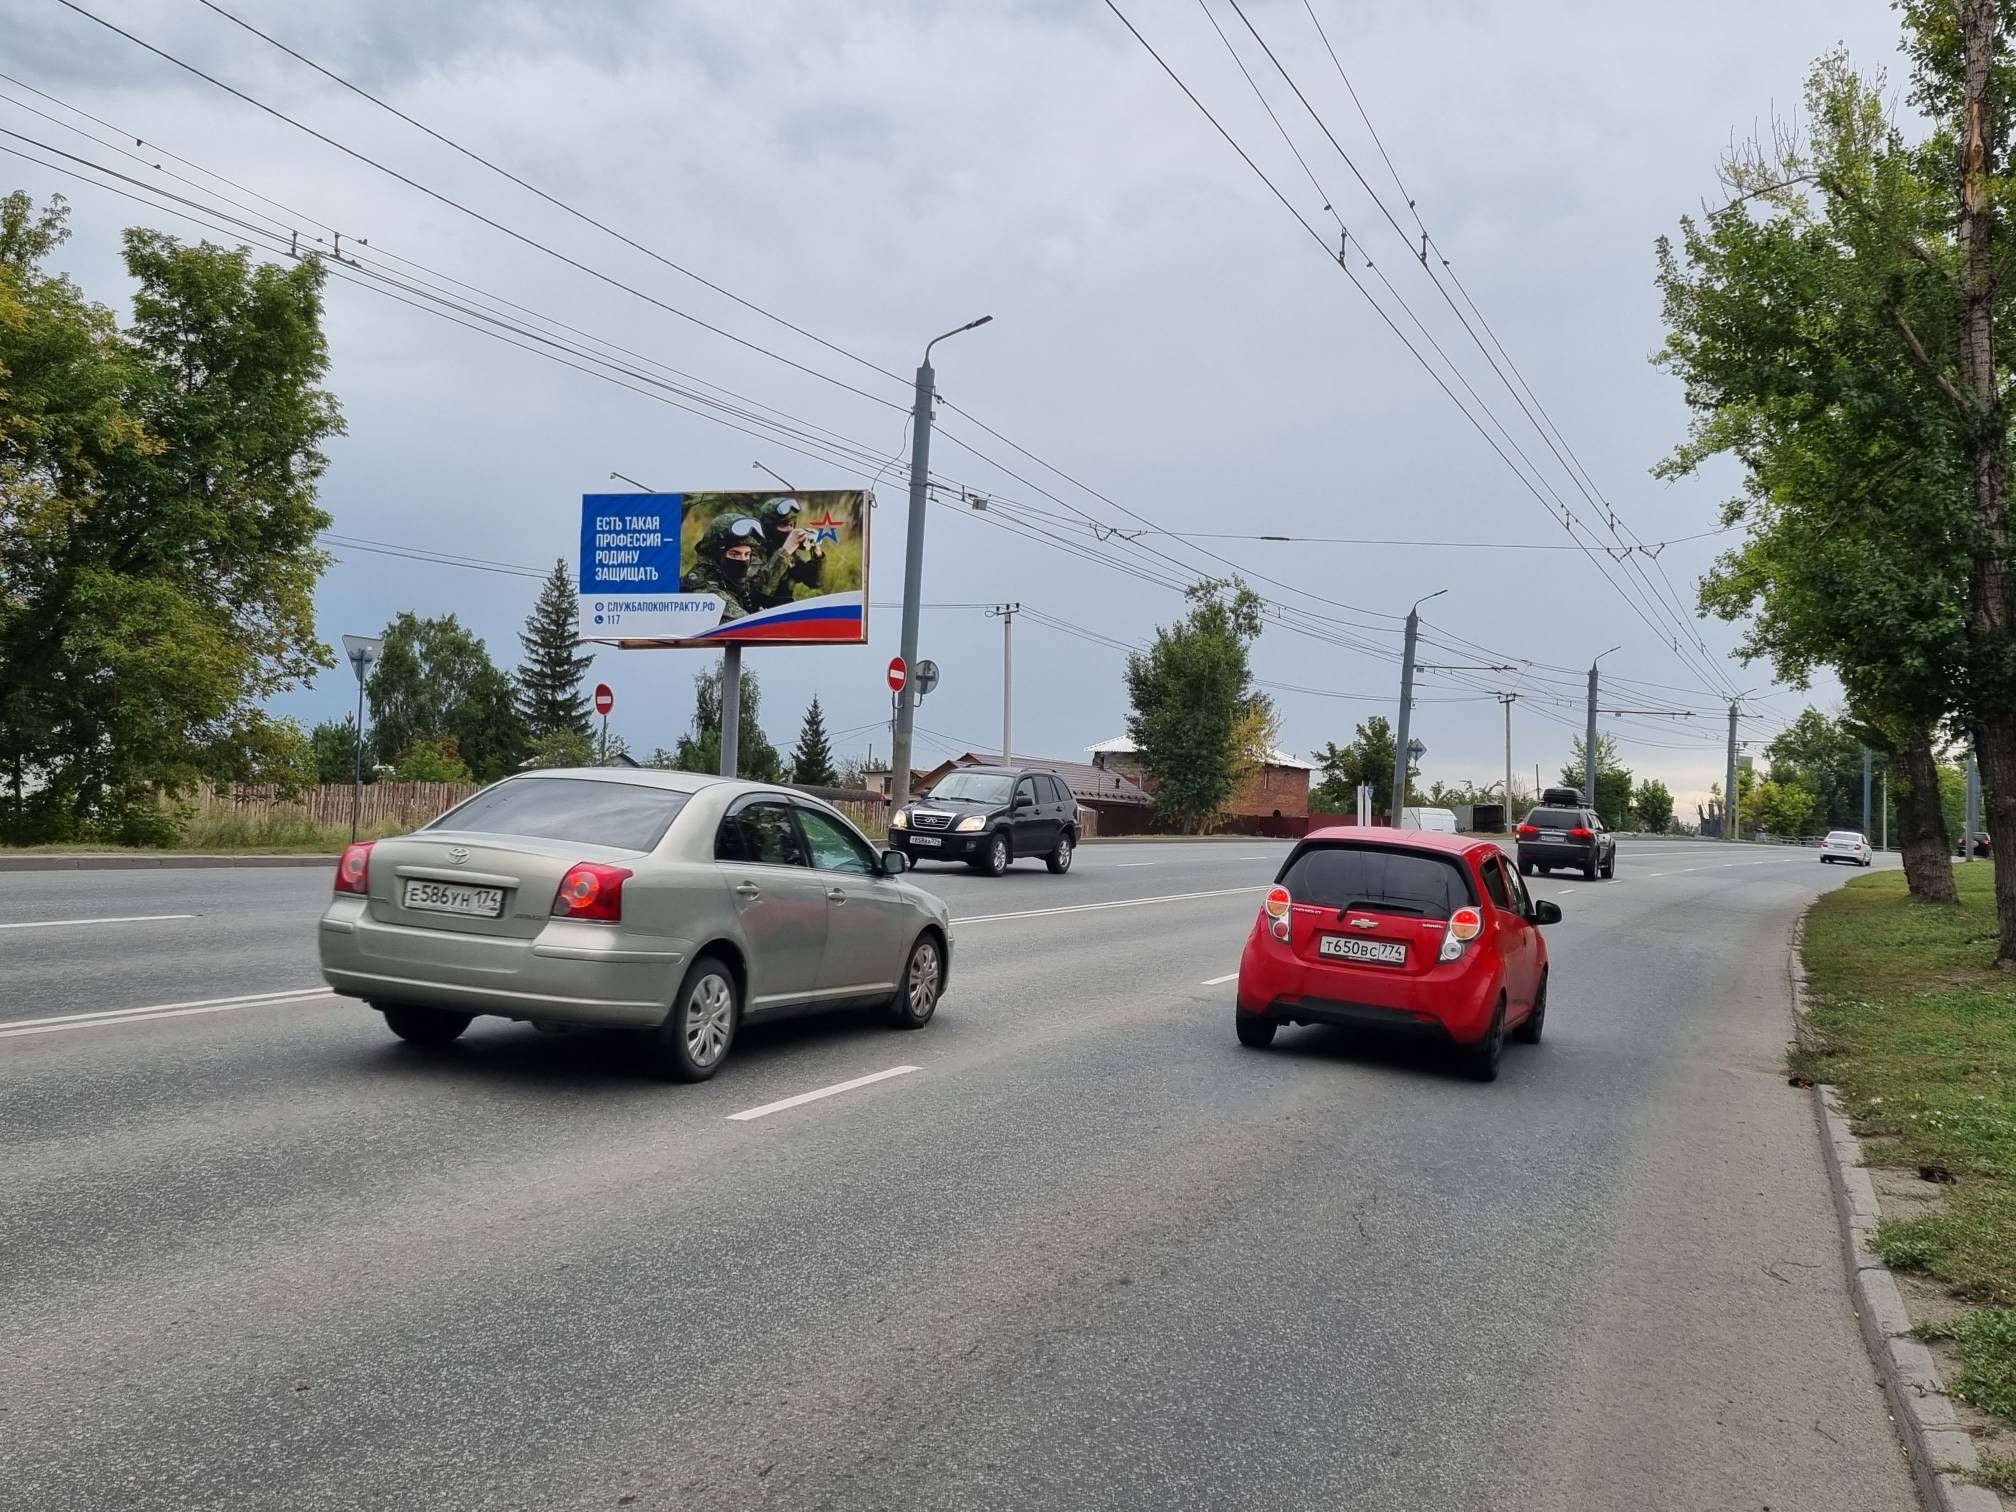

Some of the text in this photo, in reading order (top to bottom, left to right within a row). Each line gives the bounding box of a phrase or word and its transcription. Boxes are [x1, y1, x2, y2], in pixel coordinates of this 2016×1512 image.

[596, 516, 660, 530] ЕСТЬ ТАКАЯ
[596, 533, 661, 547] ПРОФЕССИЯ
[596, 550, 639, 566] РОДИНУ
[595, 567, 659, 582] ЗАЩИЩАТЬ
[607, 602, 715, 612] СЛУЖБАПОКОНТРАКТУ.РФ
[607, 615, 621, 625] 117
